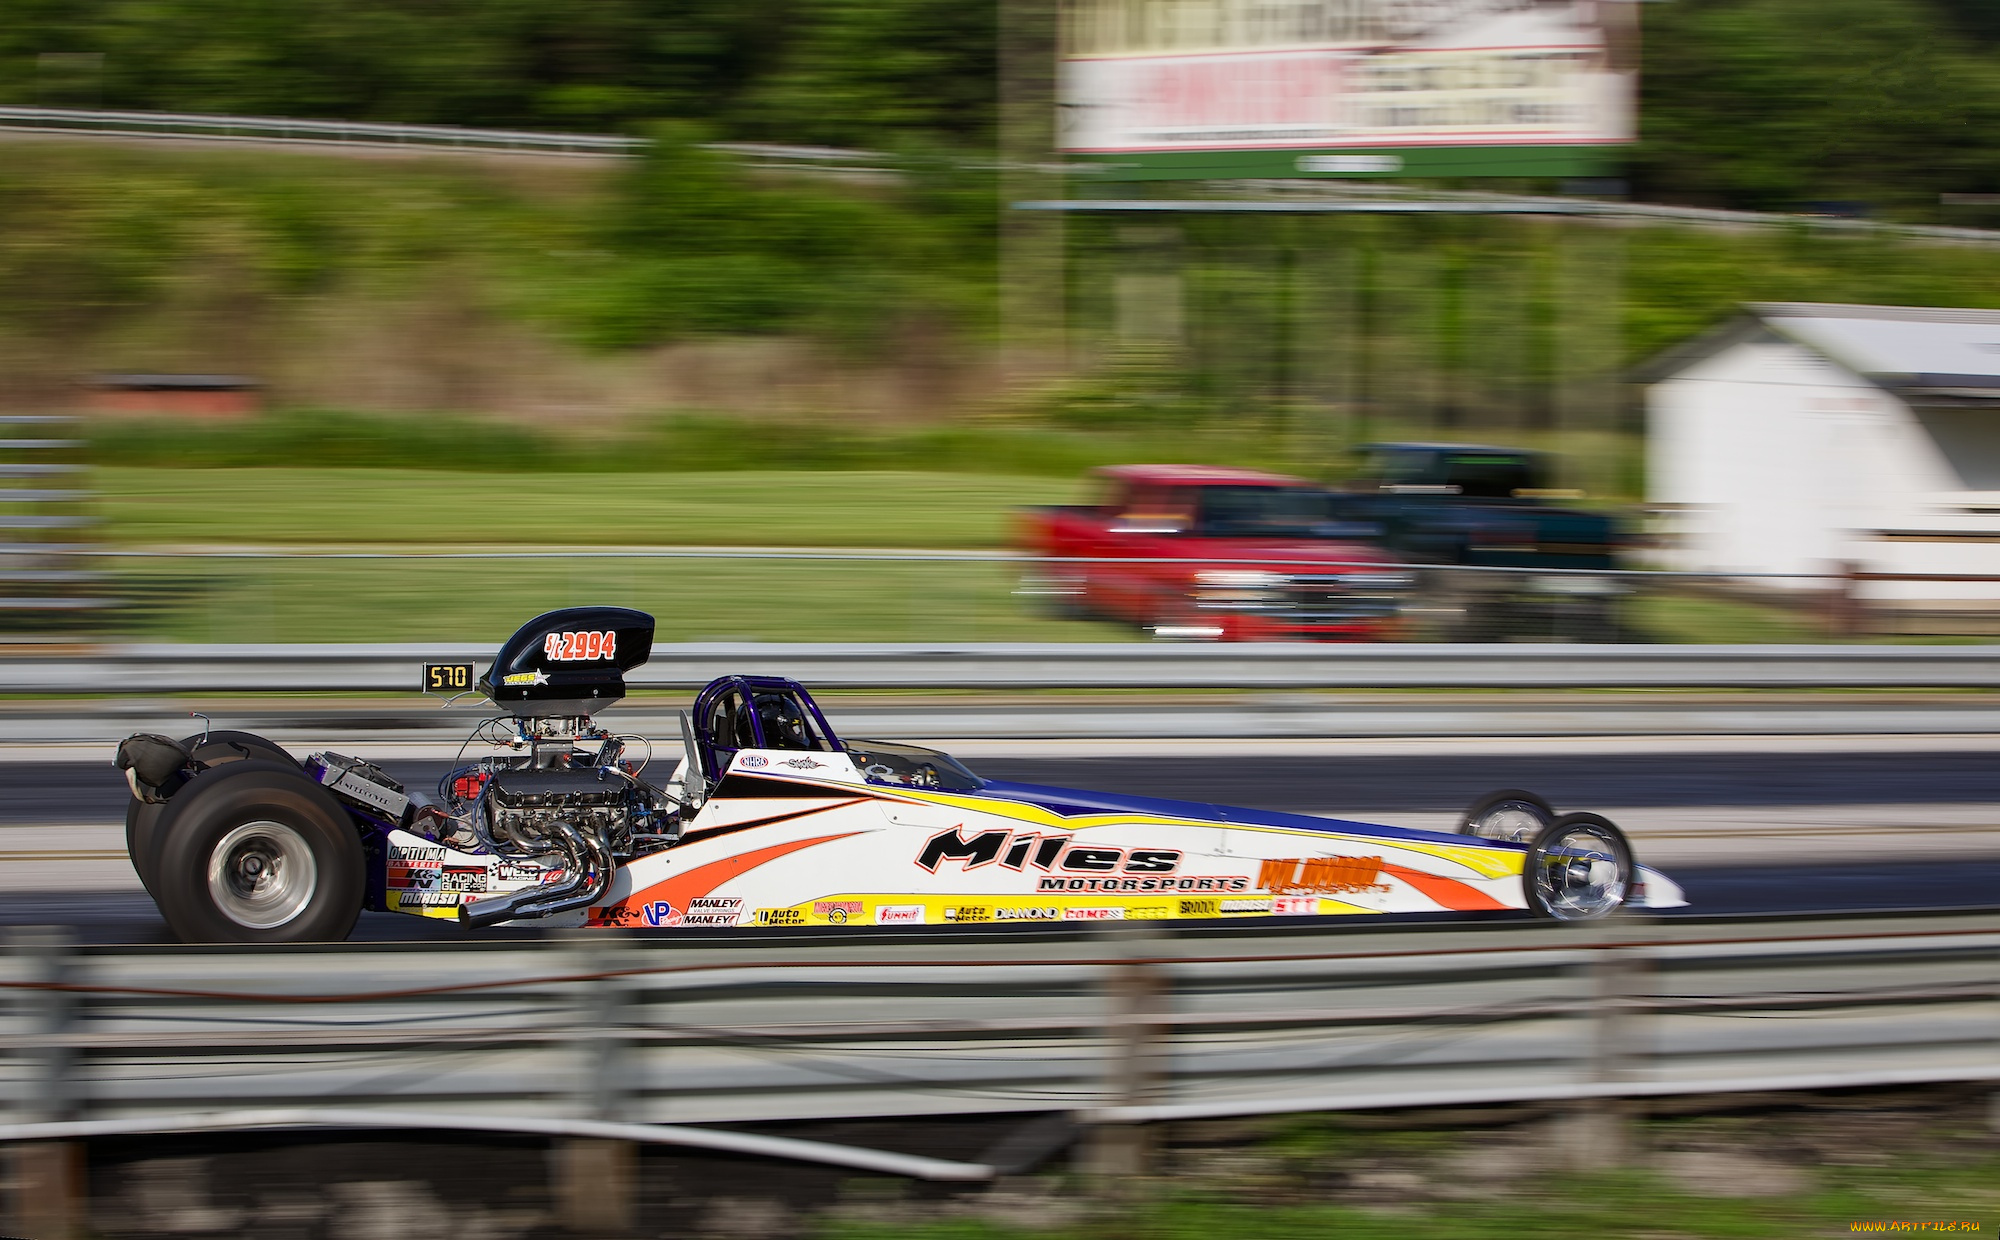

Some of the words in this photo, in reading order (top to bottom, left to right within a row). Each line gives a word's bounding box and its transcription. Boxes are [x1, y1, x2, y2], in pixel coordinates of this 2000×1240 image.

[562, 632, 614, 660] 2994
[431, 666, 467, 688] 570
[505, 674, 536, 683] JEGS
[743, 756, 766, 767] NHRA
[389, 847, 446, 860] OPTIMA
[915, 824, 1183, 874] Miles
[500, 866, 538, 877] WELD
[442, 873, 486, 882] RACING
[1036, 875, 1250, 893] MOTORSPORTS
[399, 892, 459, 906] MOROSO
[691, 900, 735, 908] MANLEY
[643, 901, 670, 926] VP
[771, 909, 799, 918] Auto
[957, 906, 985, 915] Auto
[995, 907, 1059, 919] DIAMOND
[684, 915, 730, 924] MANLEY
